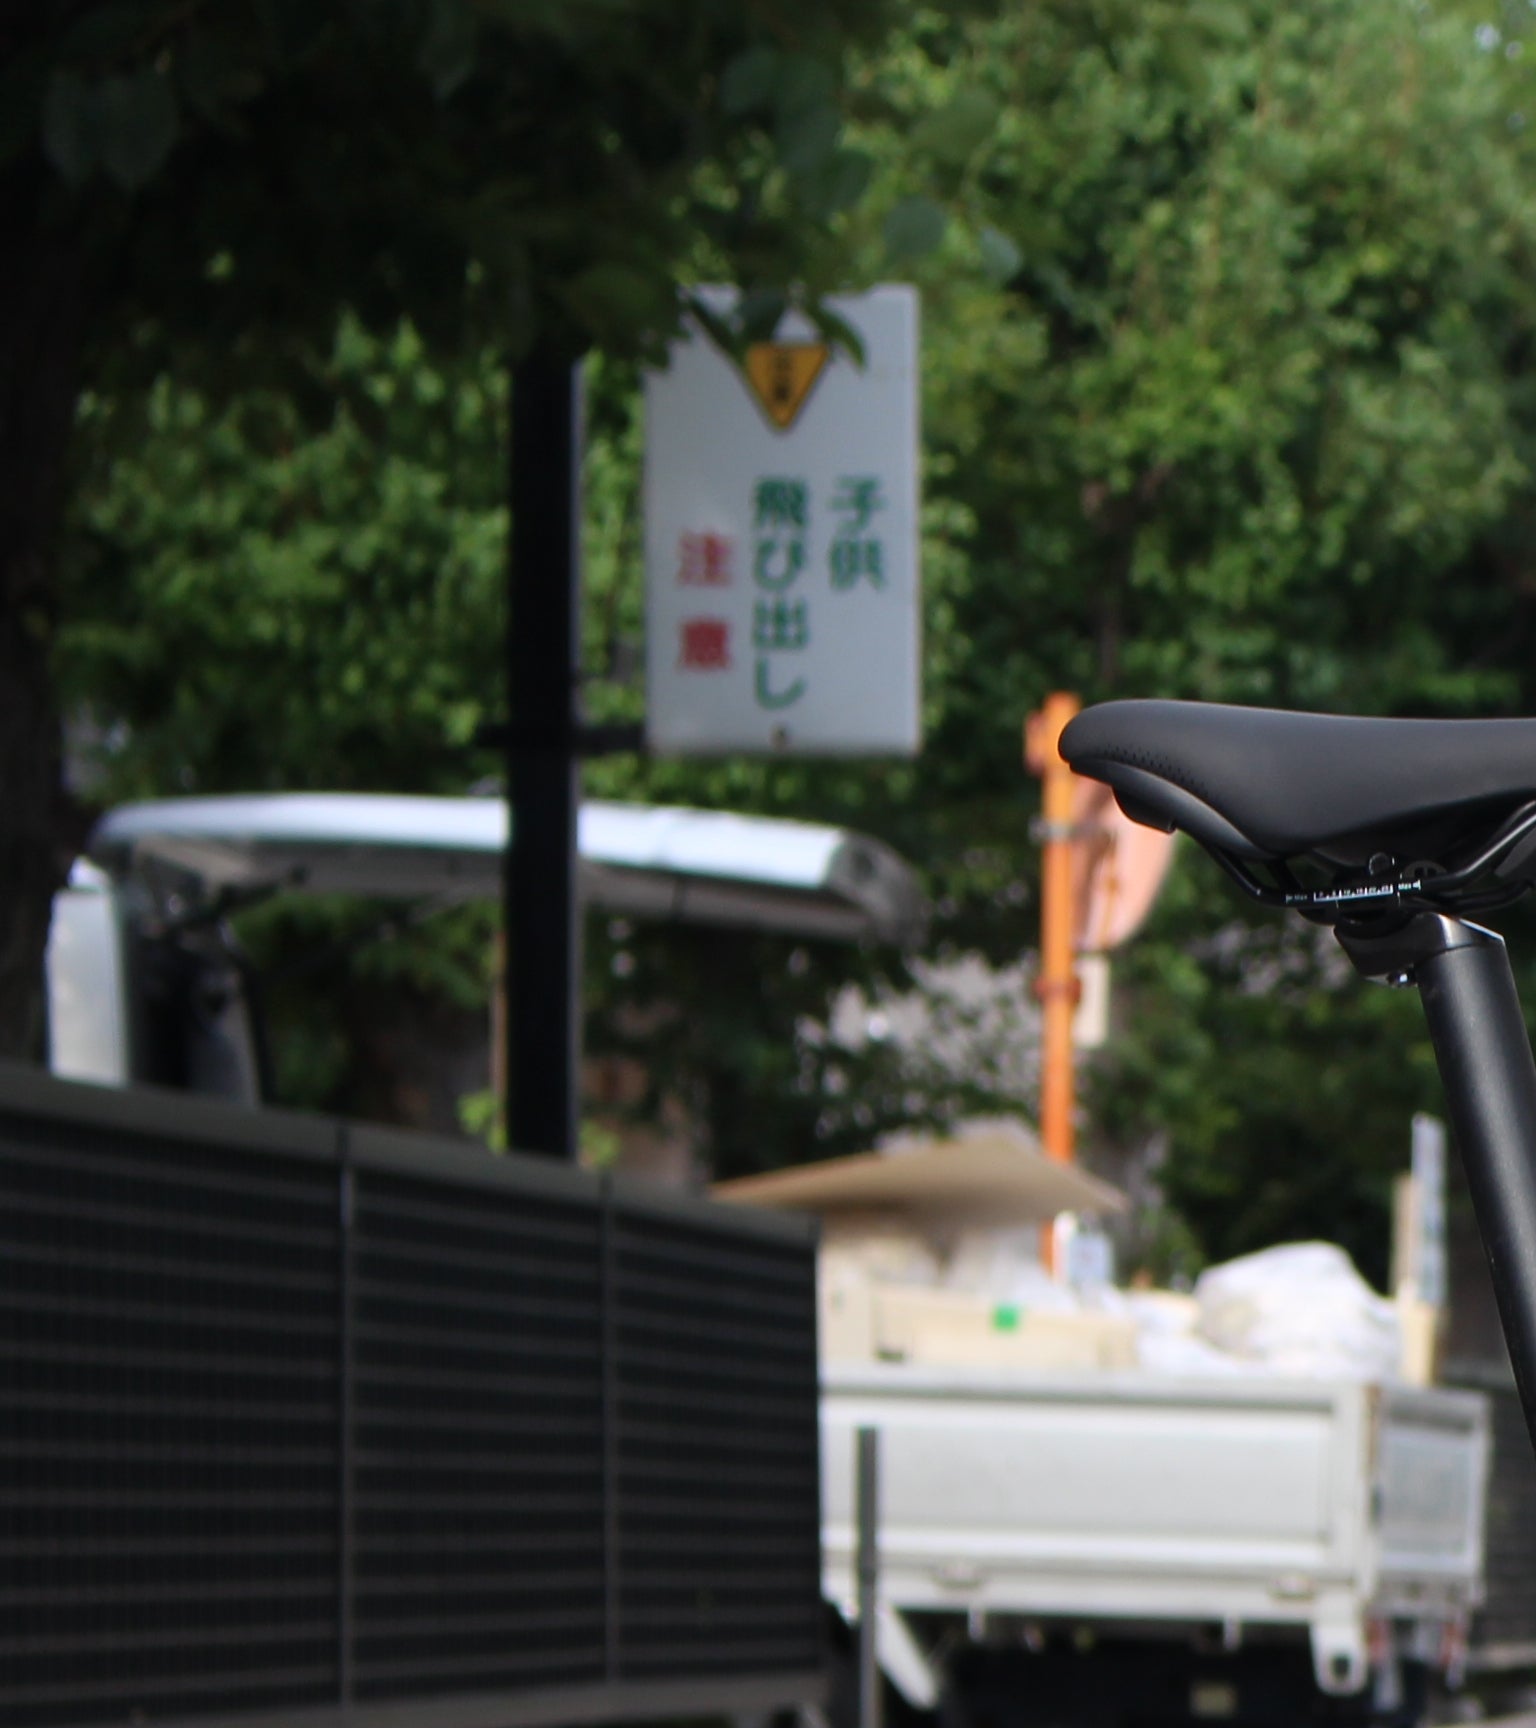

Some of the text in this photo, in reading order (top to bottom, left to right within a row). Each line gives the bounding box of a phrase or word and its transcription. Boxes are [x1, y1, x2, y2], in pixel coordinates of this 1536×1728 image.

[753, 477, 810, 710] 飛び出し
[828, 475, 887, 592] 子供
